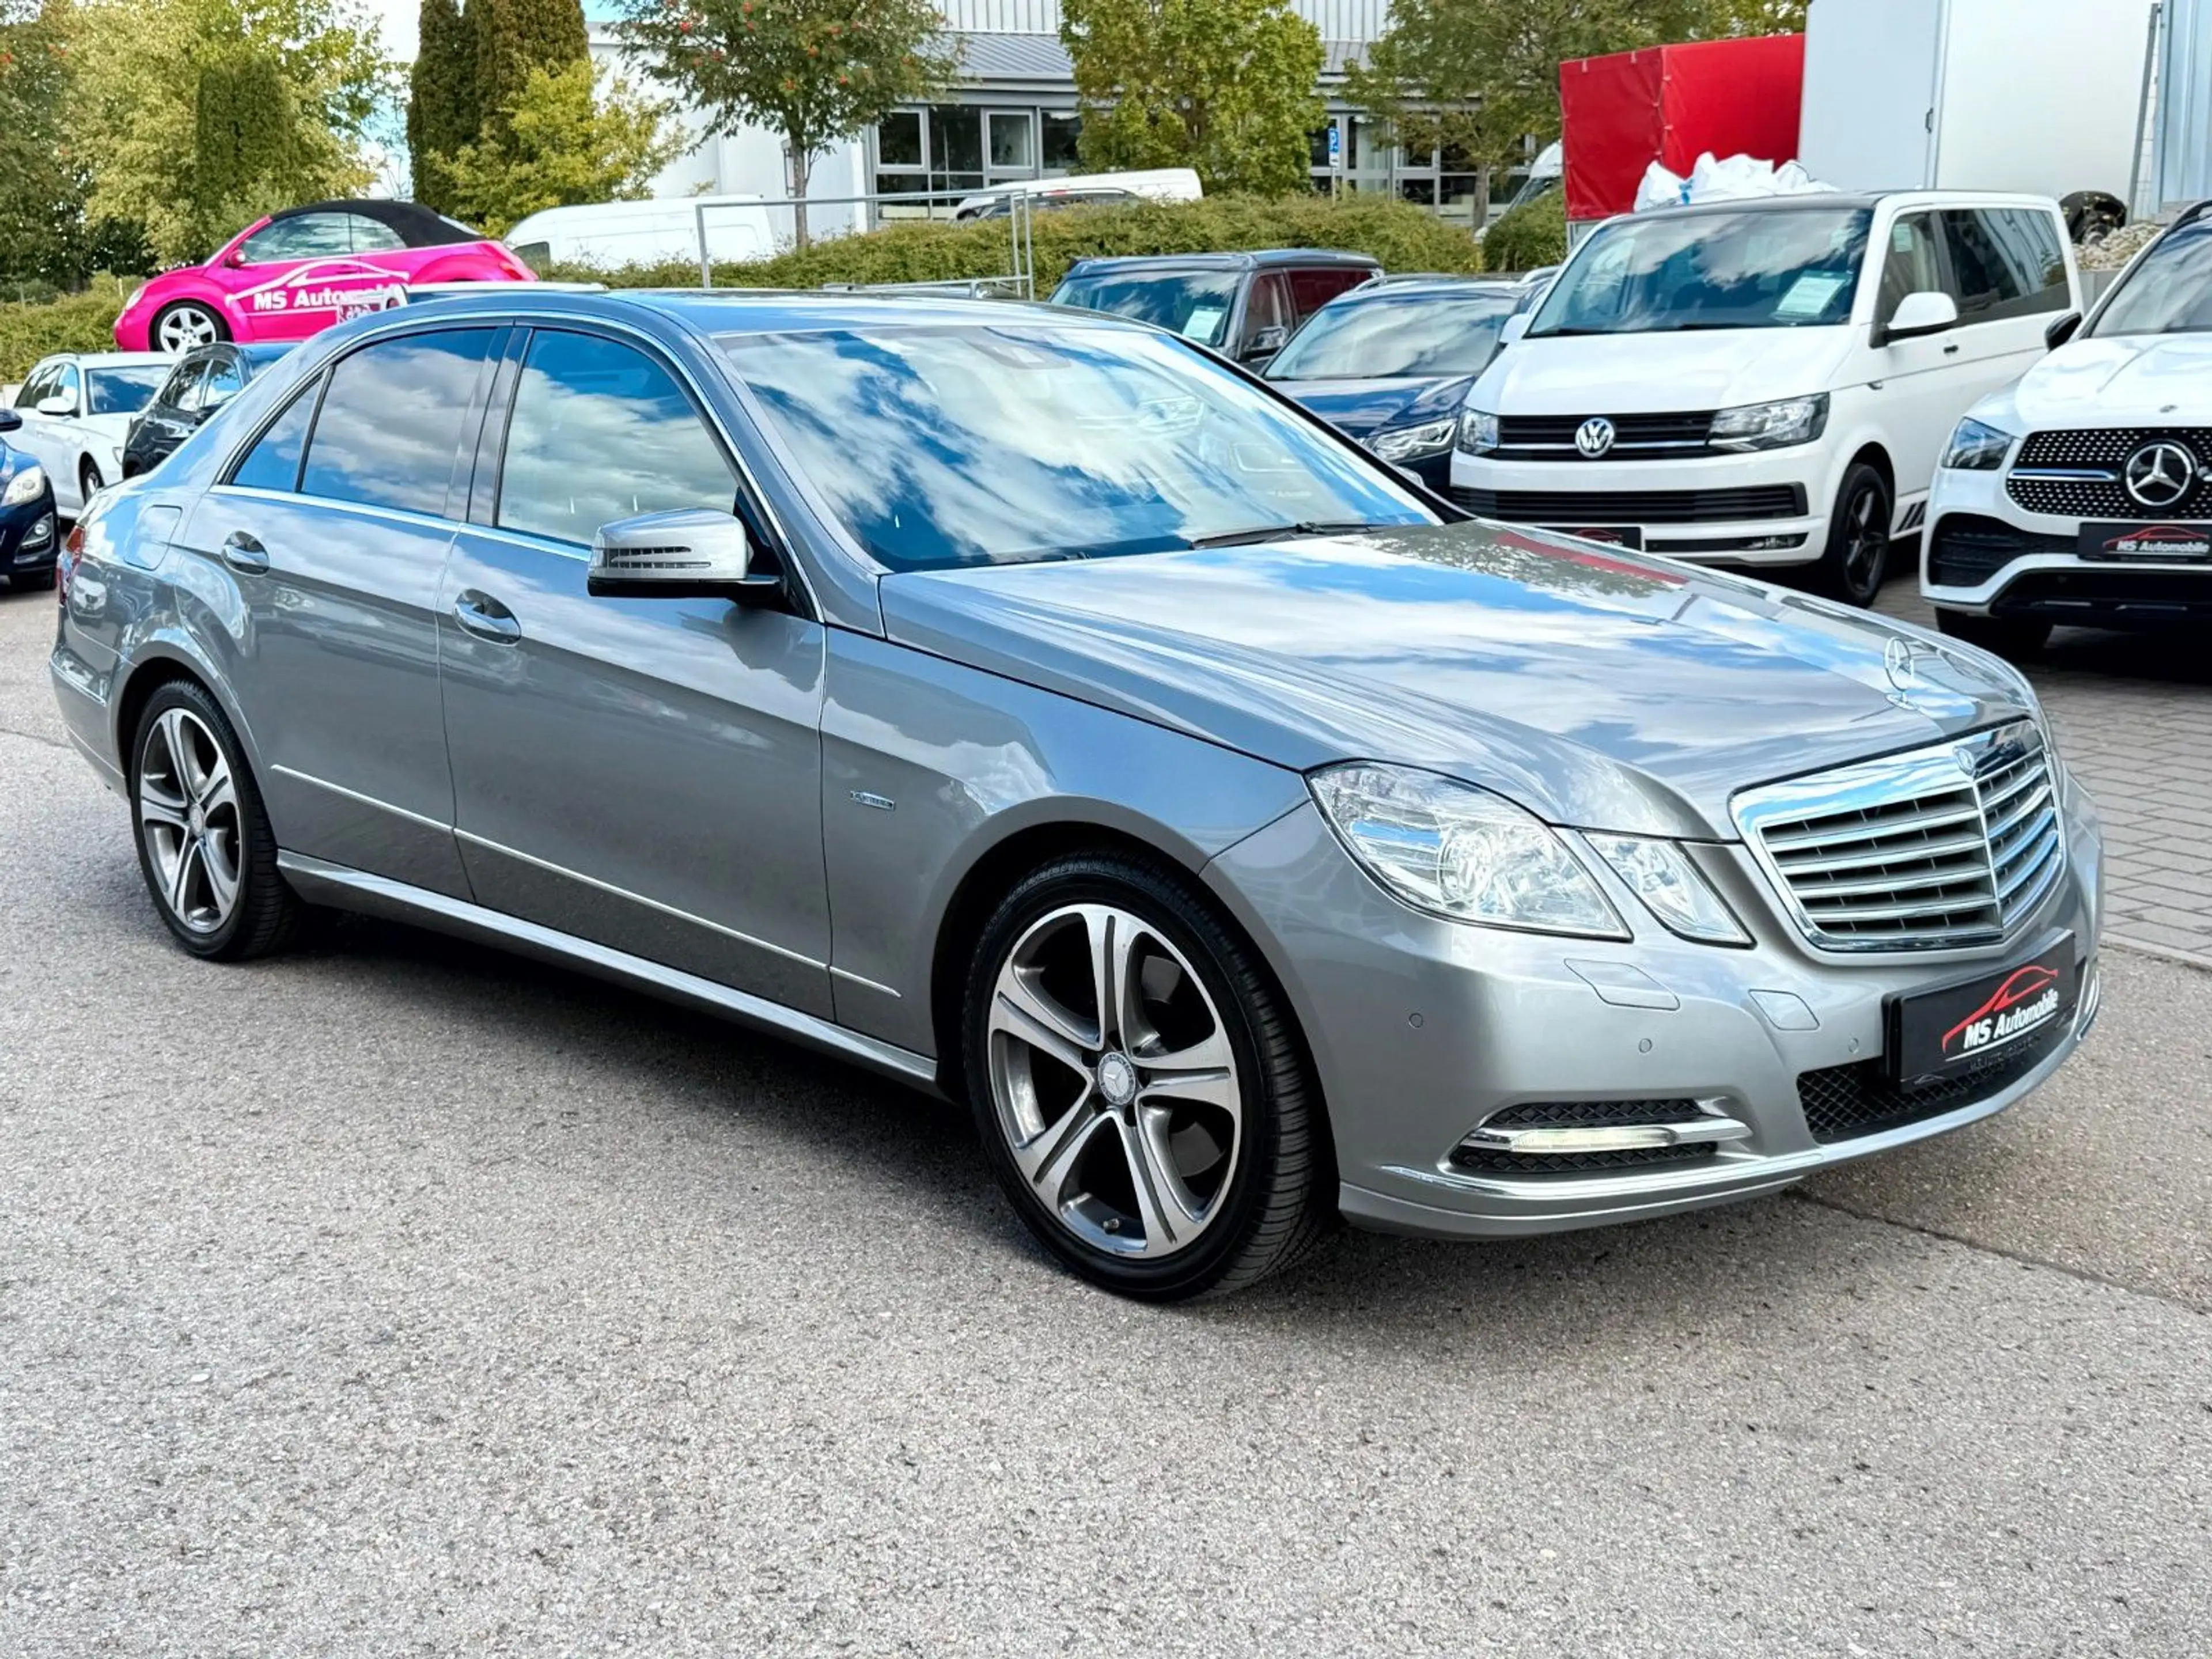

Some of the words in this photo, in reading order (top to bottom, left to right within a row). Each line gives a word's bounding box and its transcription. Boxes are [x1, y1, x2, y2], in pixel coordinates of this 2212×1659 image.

[253, 290, 287, 310] MS
[2116, 540, 2137, 551] MS
[2139, 540, 2210, 554] Automobile
[1963, 1018, 1993, 1049] MS
[1993, 988, 2059, 1039] Automobile
